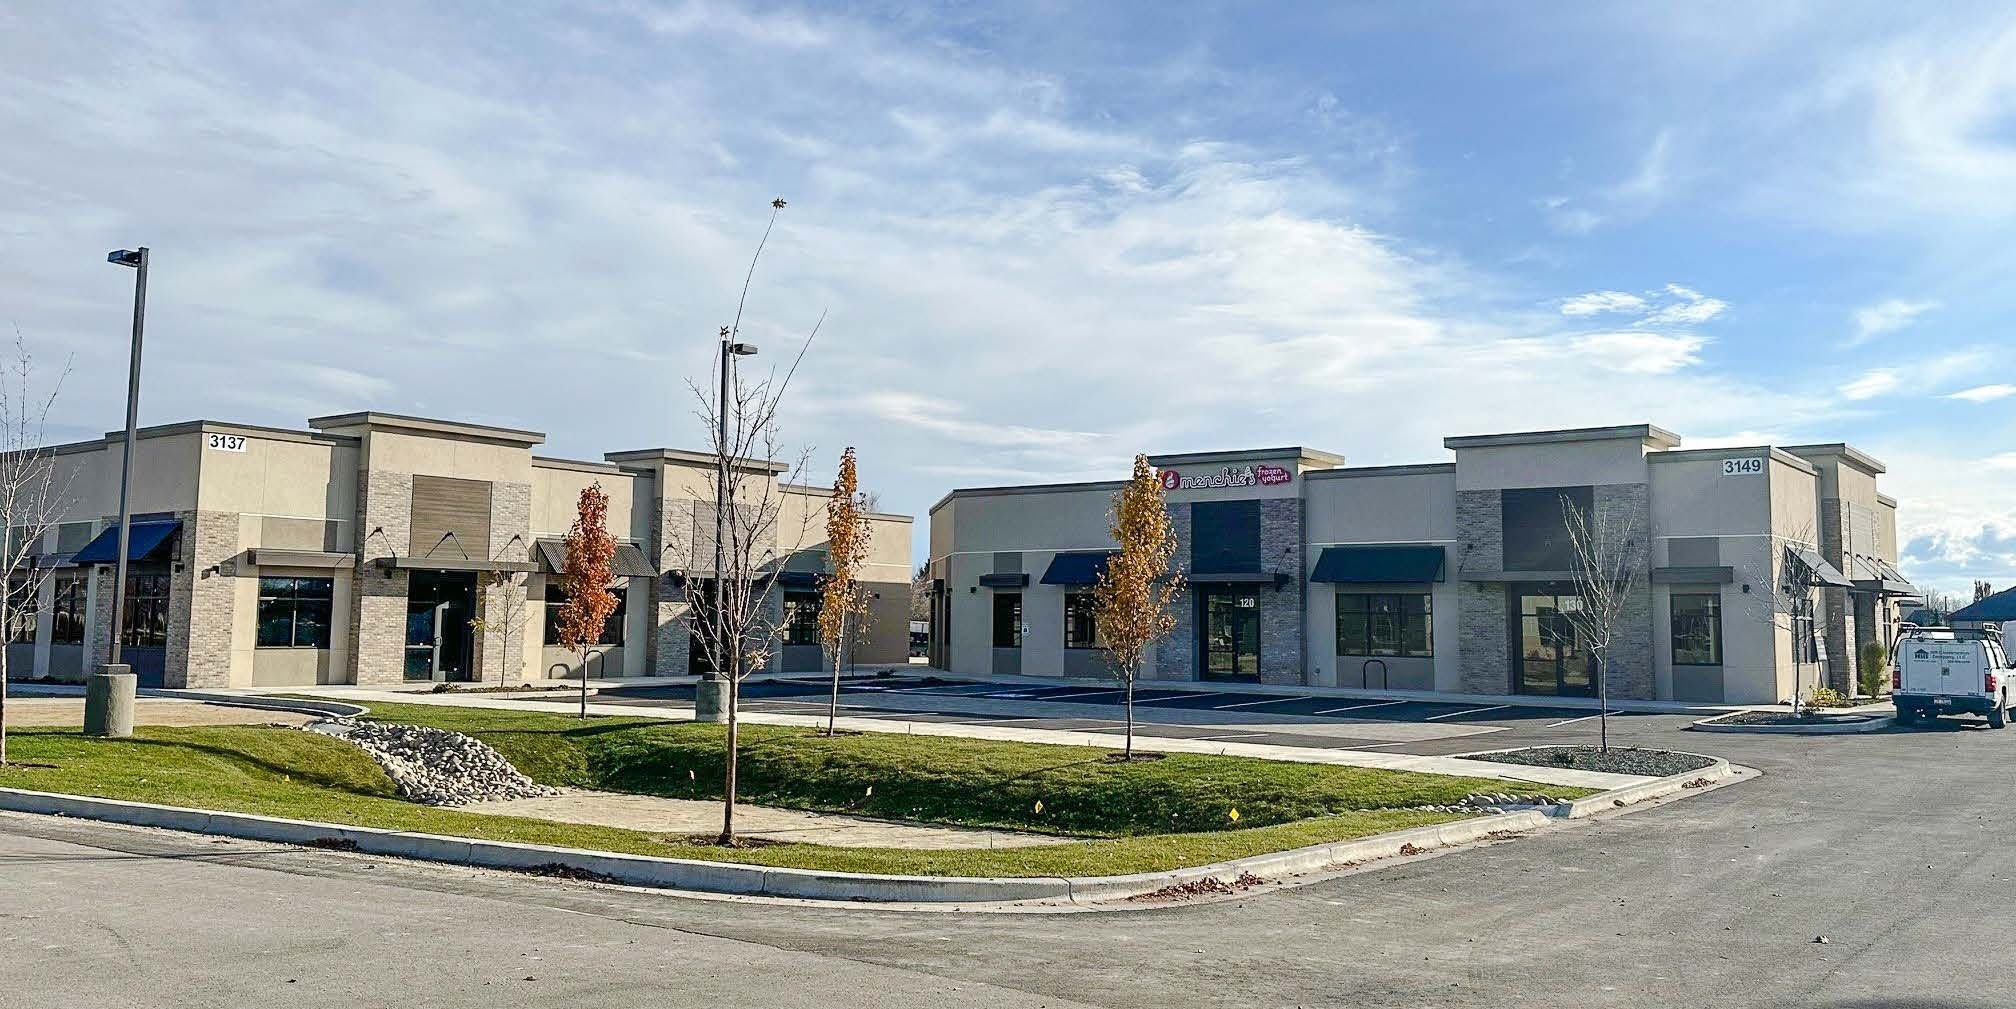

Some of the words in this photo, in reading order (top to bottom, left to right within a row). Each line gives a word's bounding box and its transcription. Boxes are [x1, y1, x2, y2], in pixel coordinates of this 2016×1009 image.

[210, 434, 246, 450] 3137
[1257, 466, 1282, 477] frozen
[1724, 459, 1761, 474] 3149
[1179, 466, 1256, 489] menchie's
[1262, 472, 1289, 483] yogurt
[1240, 598, 1255, 608] 120
[1565, 599, 1583, 611] 130
